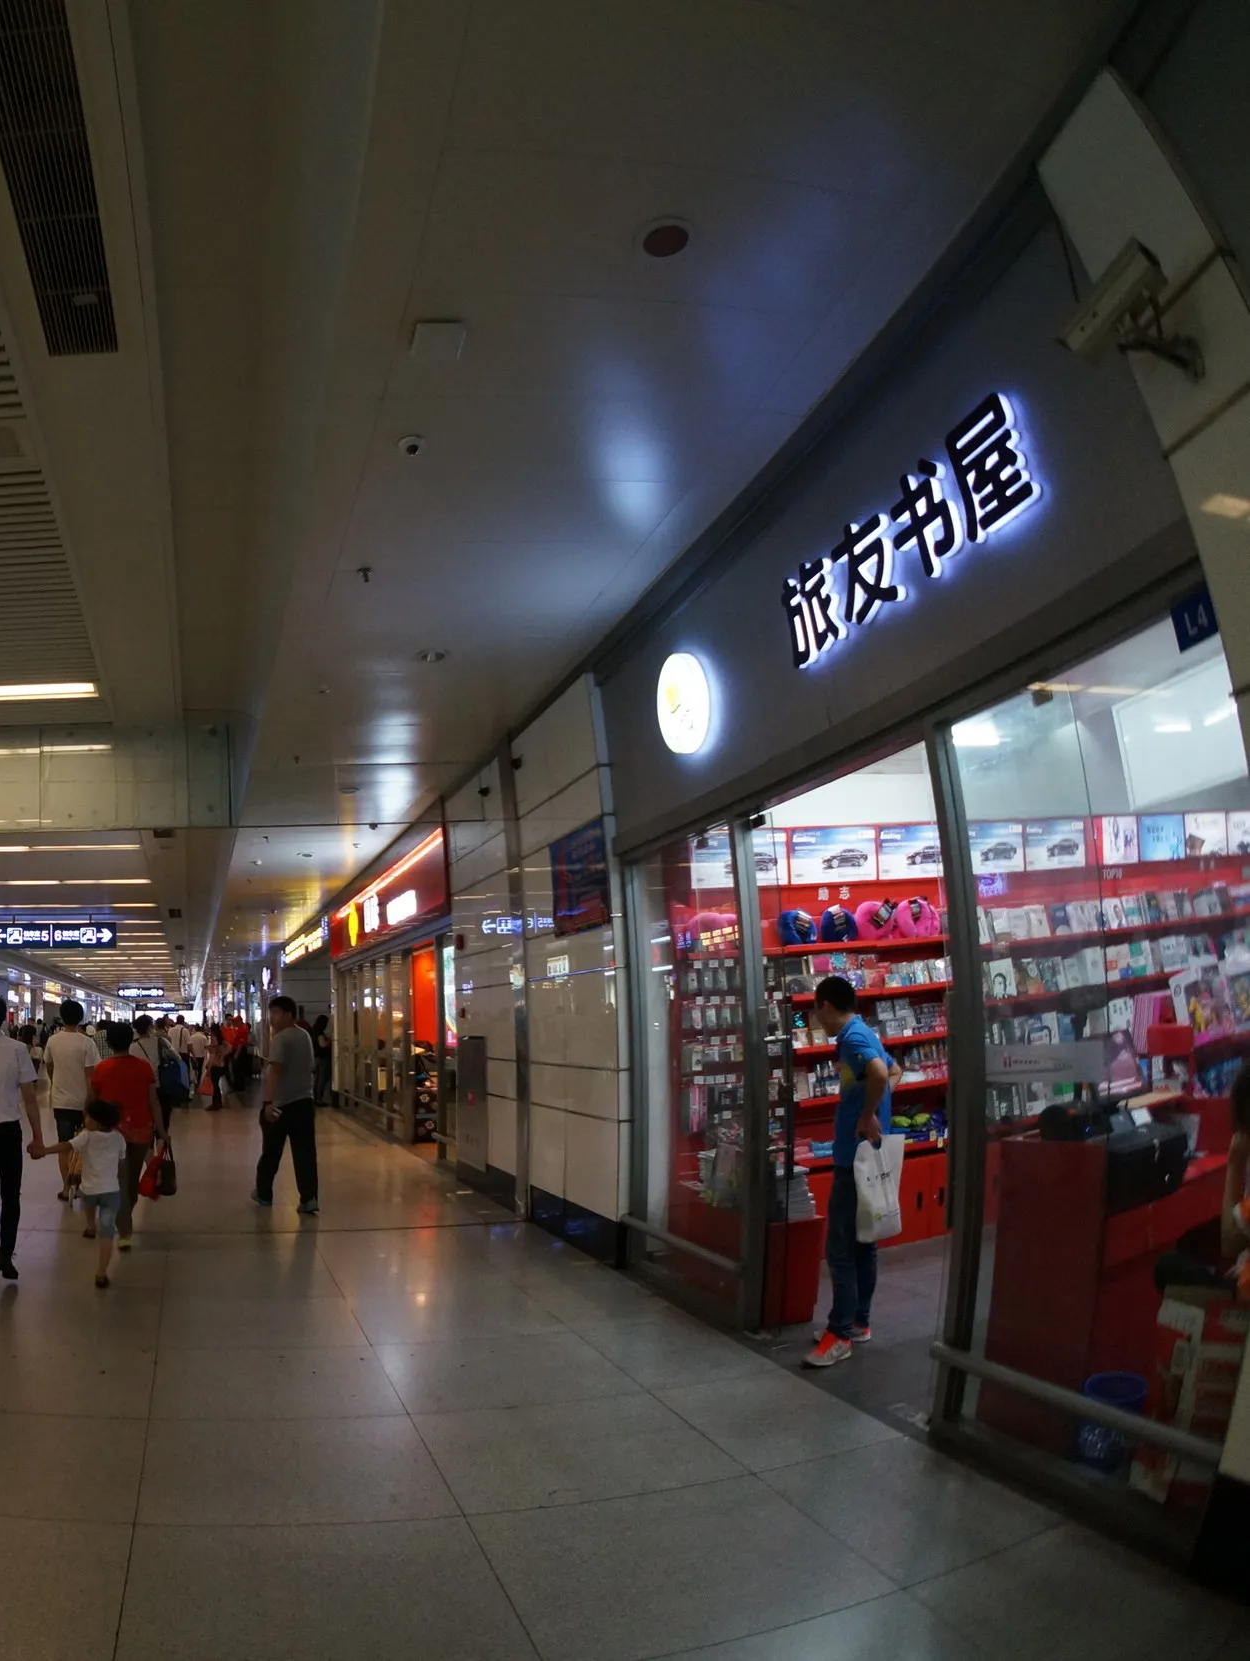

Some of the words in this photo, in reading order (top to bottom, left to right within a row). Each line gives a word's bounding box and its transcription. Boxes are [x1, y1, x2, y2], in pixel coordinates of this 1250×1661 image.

[781, 391, 1041, 670] 旅友书屋
[1184, 603, 1208, 637] L4
[1102, 868, 1123, 880] TOP10
[817, 886, 851, 901] 励志
[41, 930, 50, 942] 5
[54, 929, 63, 942] 6
